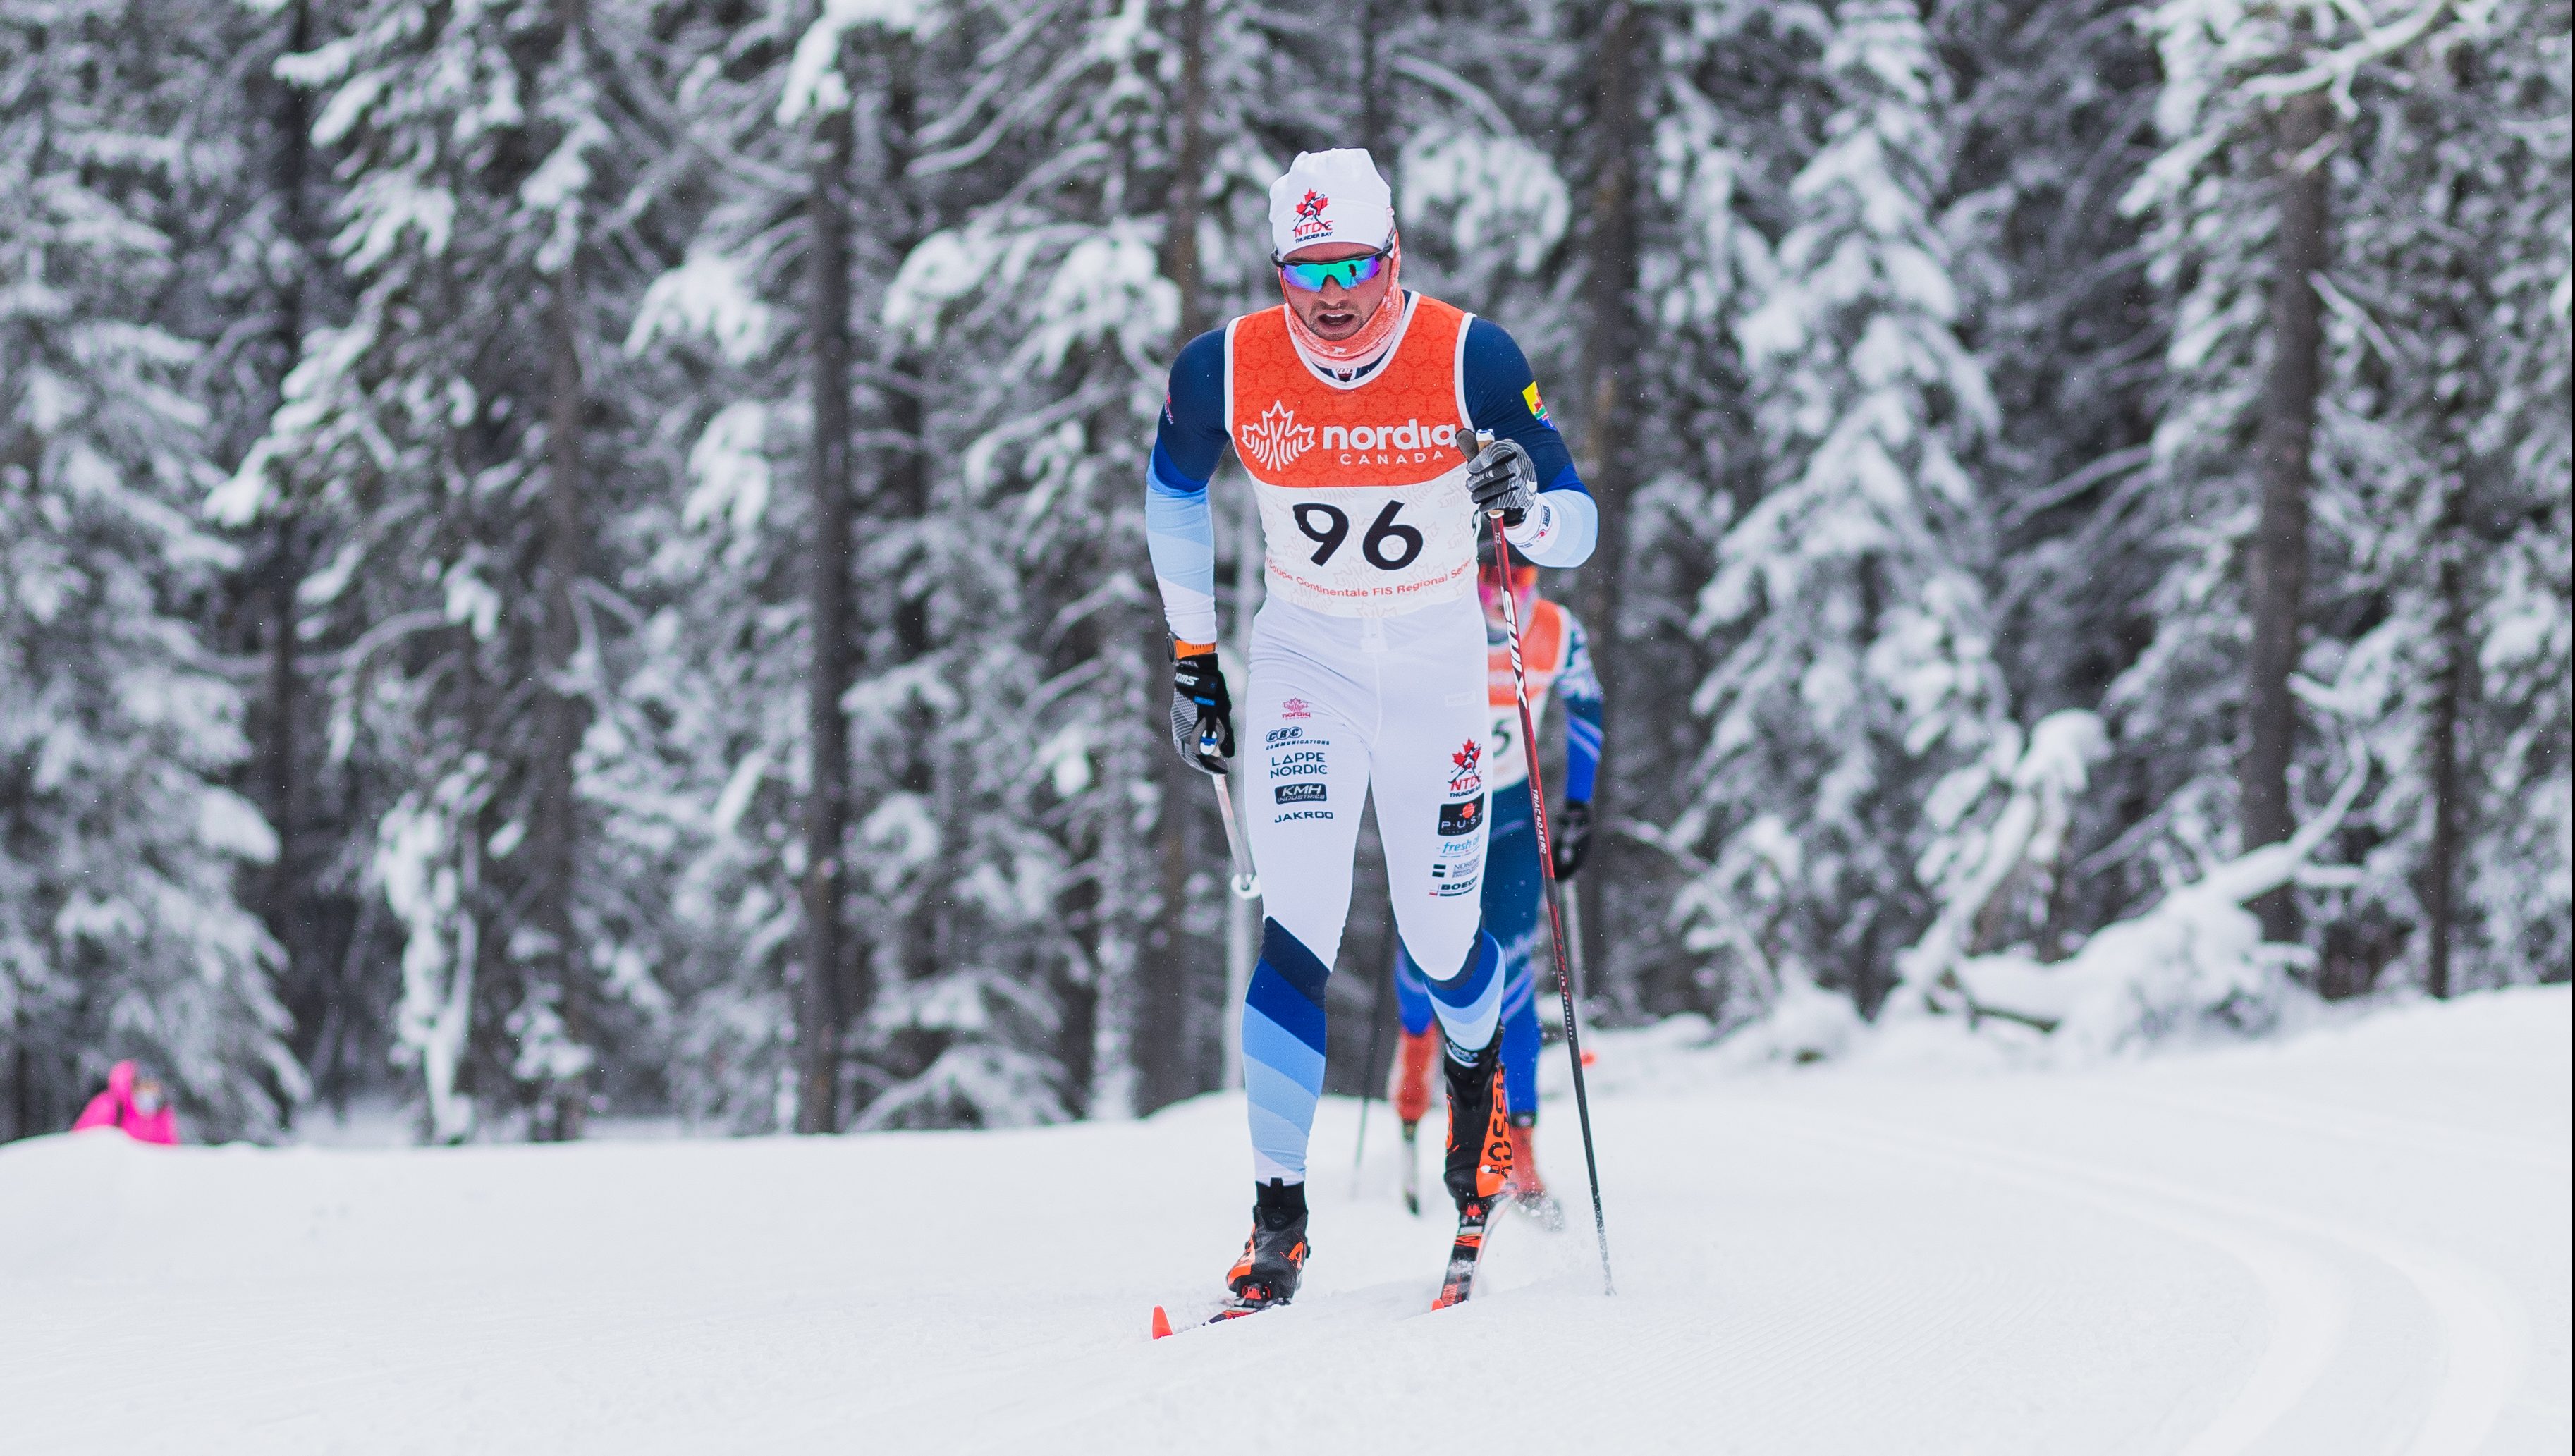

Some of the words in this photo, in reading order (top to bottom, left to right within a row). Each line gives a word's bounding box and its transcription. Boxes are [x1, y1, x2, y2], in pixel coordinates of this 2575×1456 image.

[1295, 233, 1320, 243] THUNDER
[1340, 450, 1444, 465] CANADA
[1292, 499, 1424, 570] 96
[1296, 576, 1369, 597] Continentale
[1372, 587, 1393, 597] FIS
[1397, 574, 1448, 594] Regional
[1500, 586, 1528, 710] SWIX
[1267, 728, 1301, 741] CRC
[1266, 739, 1330, 750] COMMUNICATIONS
[1271, 752, 1326, 766] LAPPE
[1270, 764, 1328, 779] NORDIC
[1277, 794, 1325, 802] INDUSTRIES
[1282, 785, 1322, 797] KMH
[1274, 811, 1334, 824] JAKROO
[1442, 839, 1472, 854] fresh
